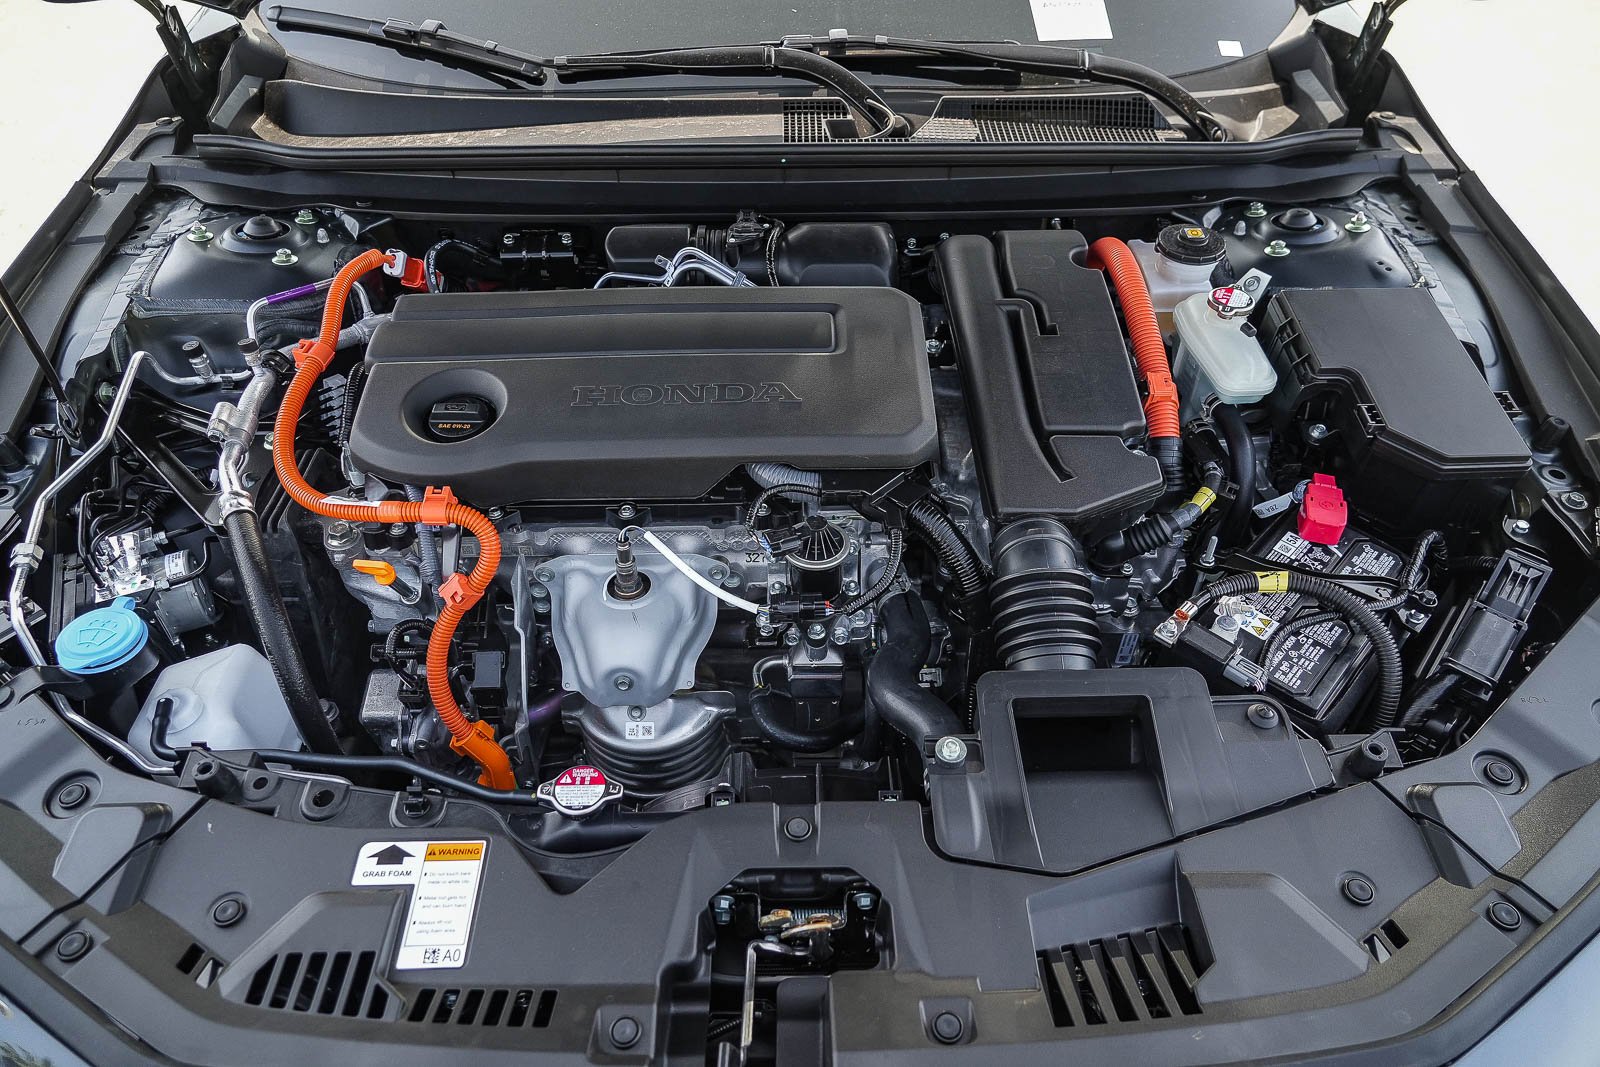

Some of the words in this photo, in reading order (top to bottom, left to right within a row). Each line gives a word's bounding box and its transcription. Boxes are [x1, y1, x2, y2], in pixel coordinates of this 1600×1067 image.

[570, 381, 803, 407] HONDA
[437, 847, 480, 856] WARNING
[362, 870, 386, 878] GRAB
